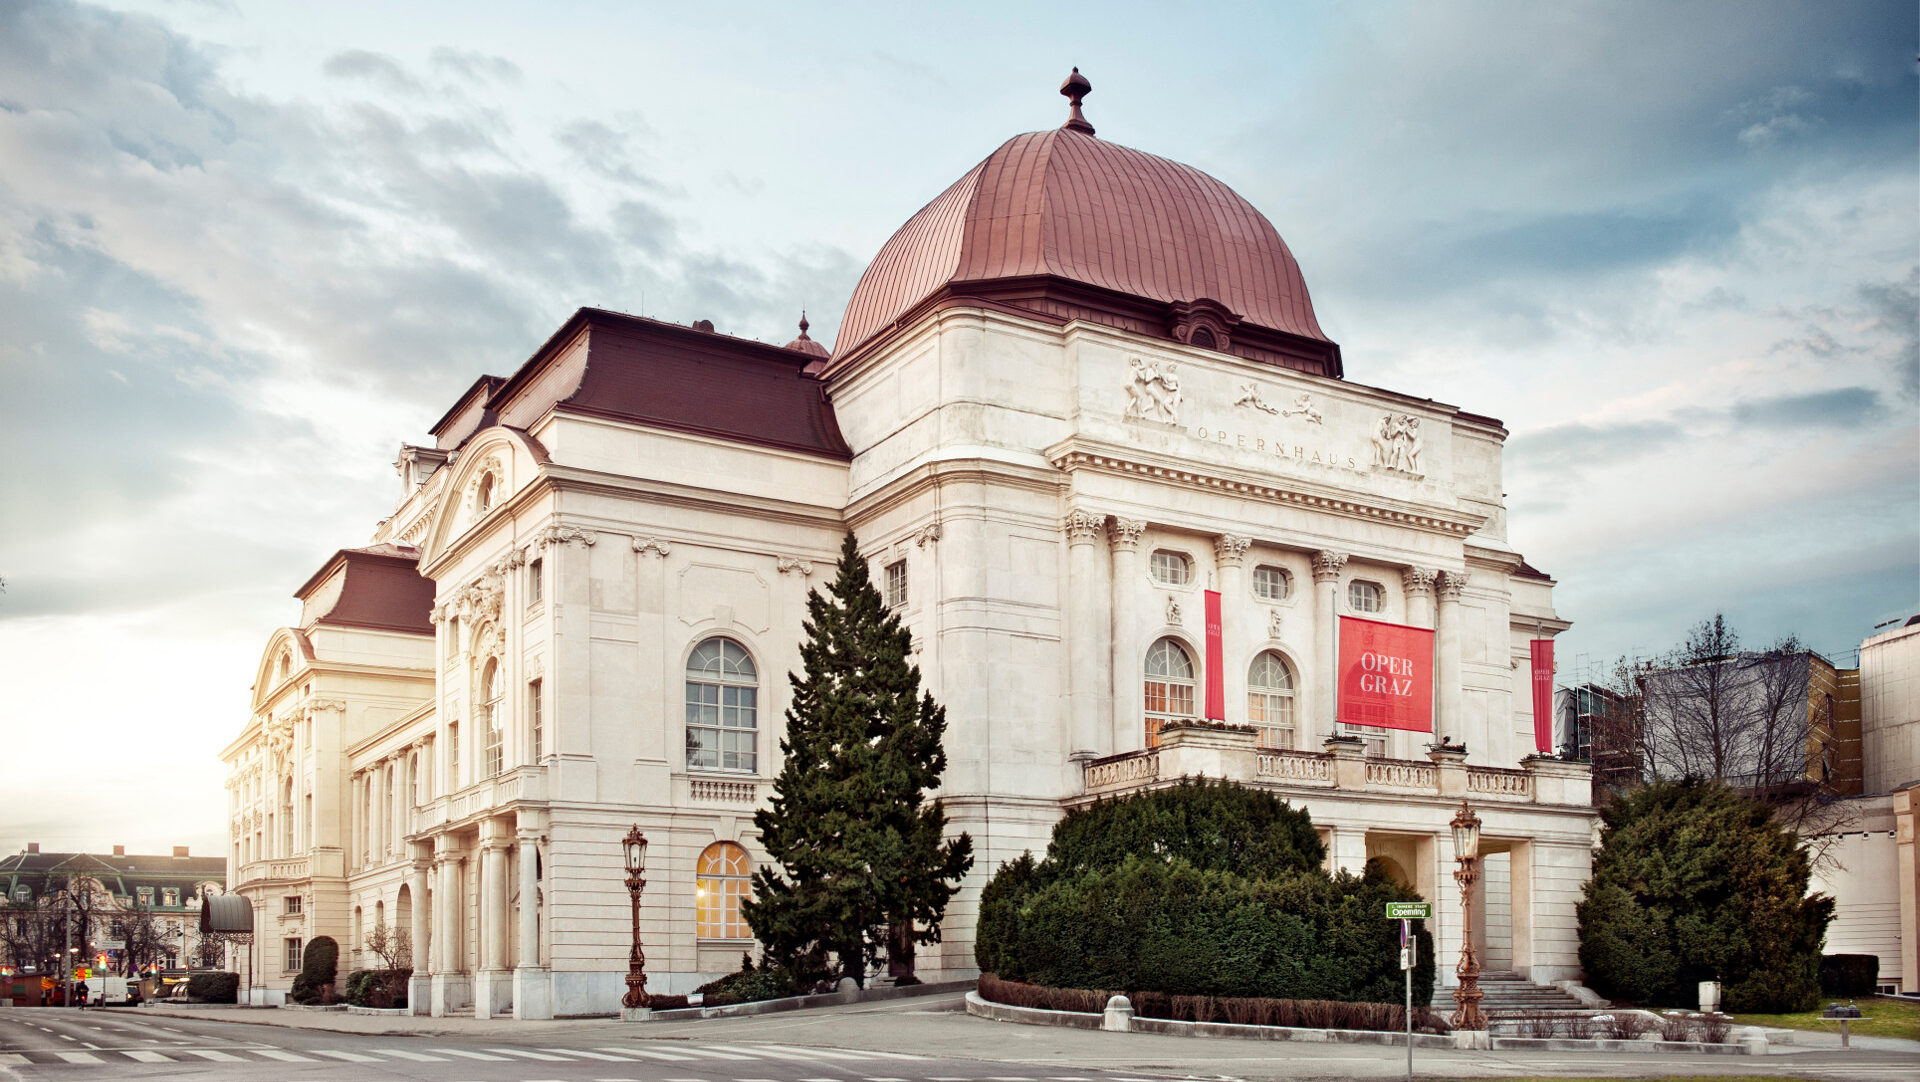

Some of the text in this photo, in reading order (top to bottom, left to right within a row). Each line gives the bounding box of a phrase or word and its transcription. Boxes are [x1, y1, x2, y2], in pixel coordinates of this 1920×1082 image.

[1198, 426, 1356, 469] OPERNHAUS
[1361, 651, 1413, 677] OPER
[1360, 673, 1413, 697] GRAZ
